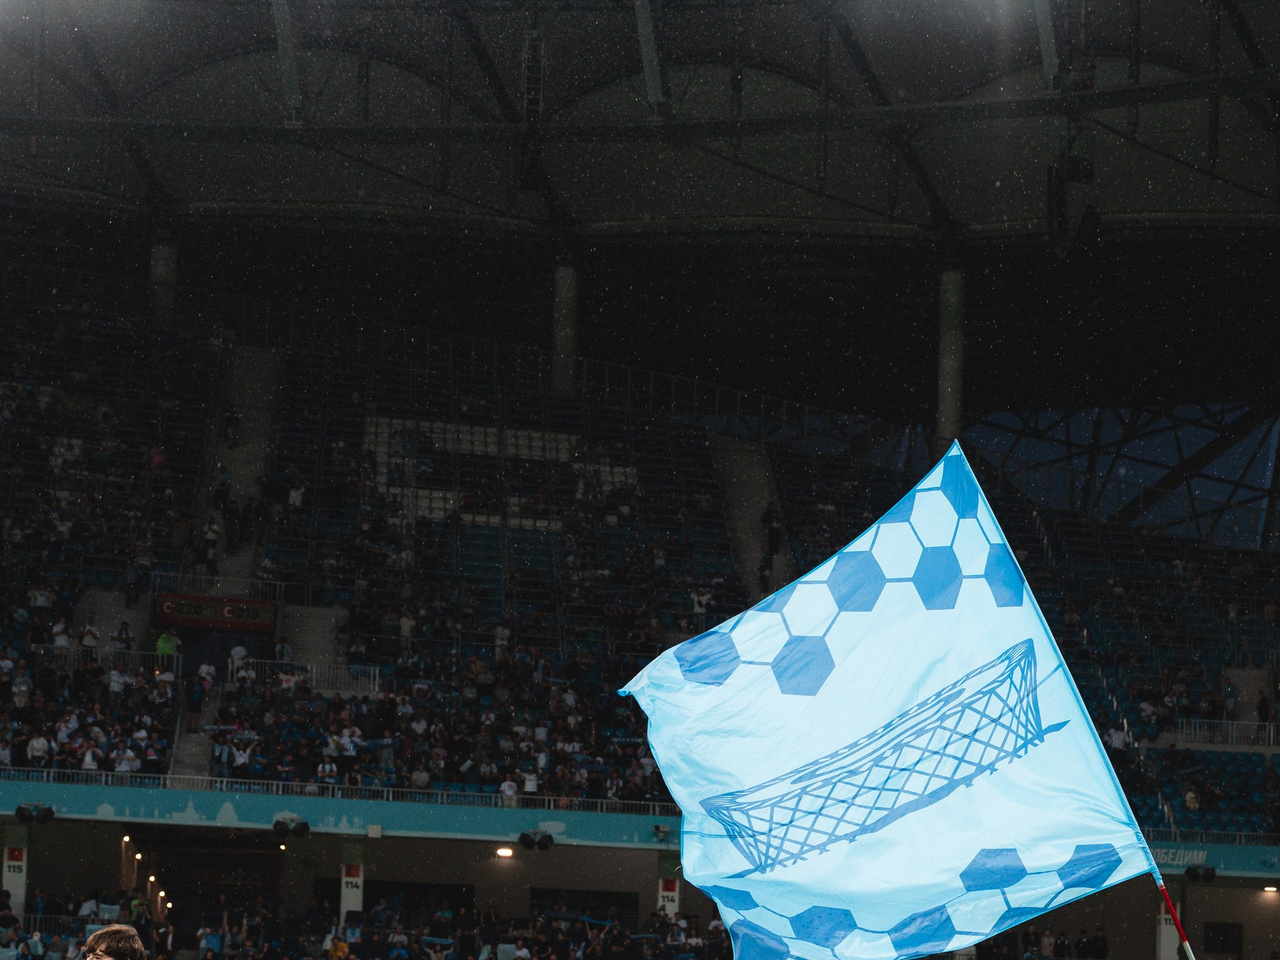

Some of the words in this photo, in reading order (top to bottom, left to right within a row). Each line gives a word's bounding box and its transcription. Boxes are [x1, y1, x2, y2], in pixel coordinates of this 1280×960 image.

[1151, 848, 1208, 867] ОБЕДИМ!
[7, 864, 23, 874] 115
[345, 880, 360, 890] 114
[661, 894, 676, 904] 114
